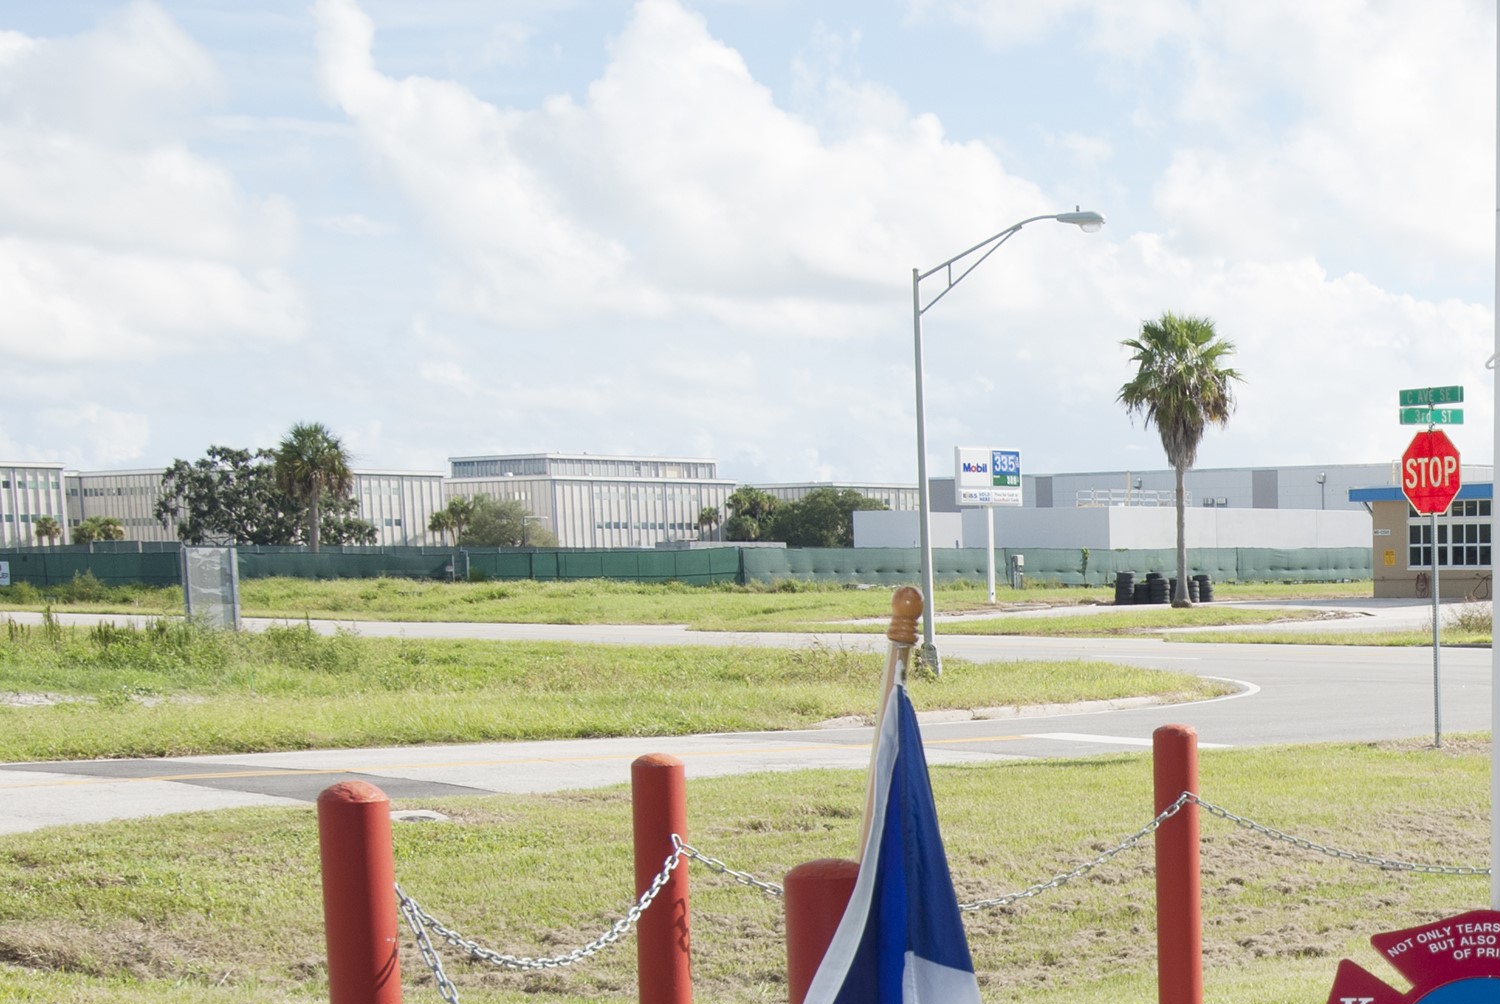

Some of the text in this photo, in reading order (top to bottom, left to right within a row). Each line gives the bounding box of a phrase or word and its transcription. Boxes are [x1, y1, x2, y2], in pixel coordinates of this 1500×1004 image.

[1407, 387, 1451, 404] C AVE SE
[1415, 409, 1453, 423] 3rd ST
[963, 463, 987, 473] Mobil
[1405, 456, 1457, 489] STOP
[1387, 939, 1414, 958] NOT
[1416, 926, 1451, 944] ONLY
[1455, 922, 1500, 934] TEARS
[1428, 938, 1455, 954] BUT
[1459, 935, 1496, 946] ALSO
[1453, 949, 1471, 960] OF
